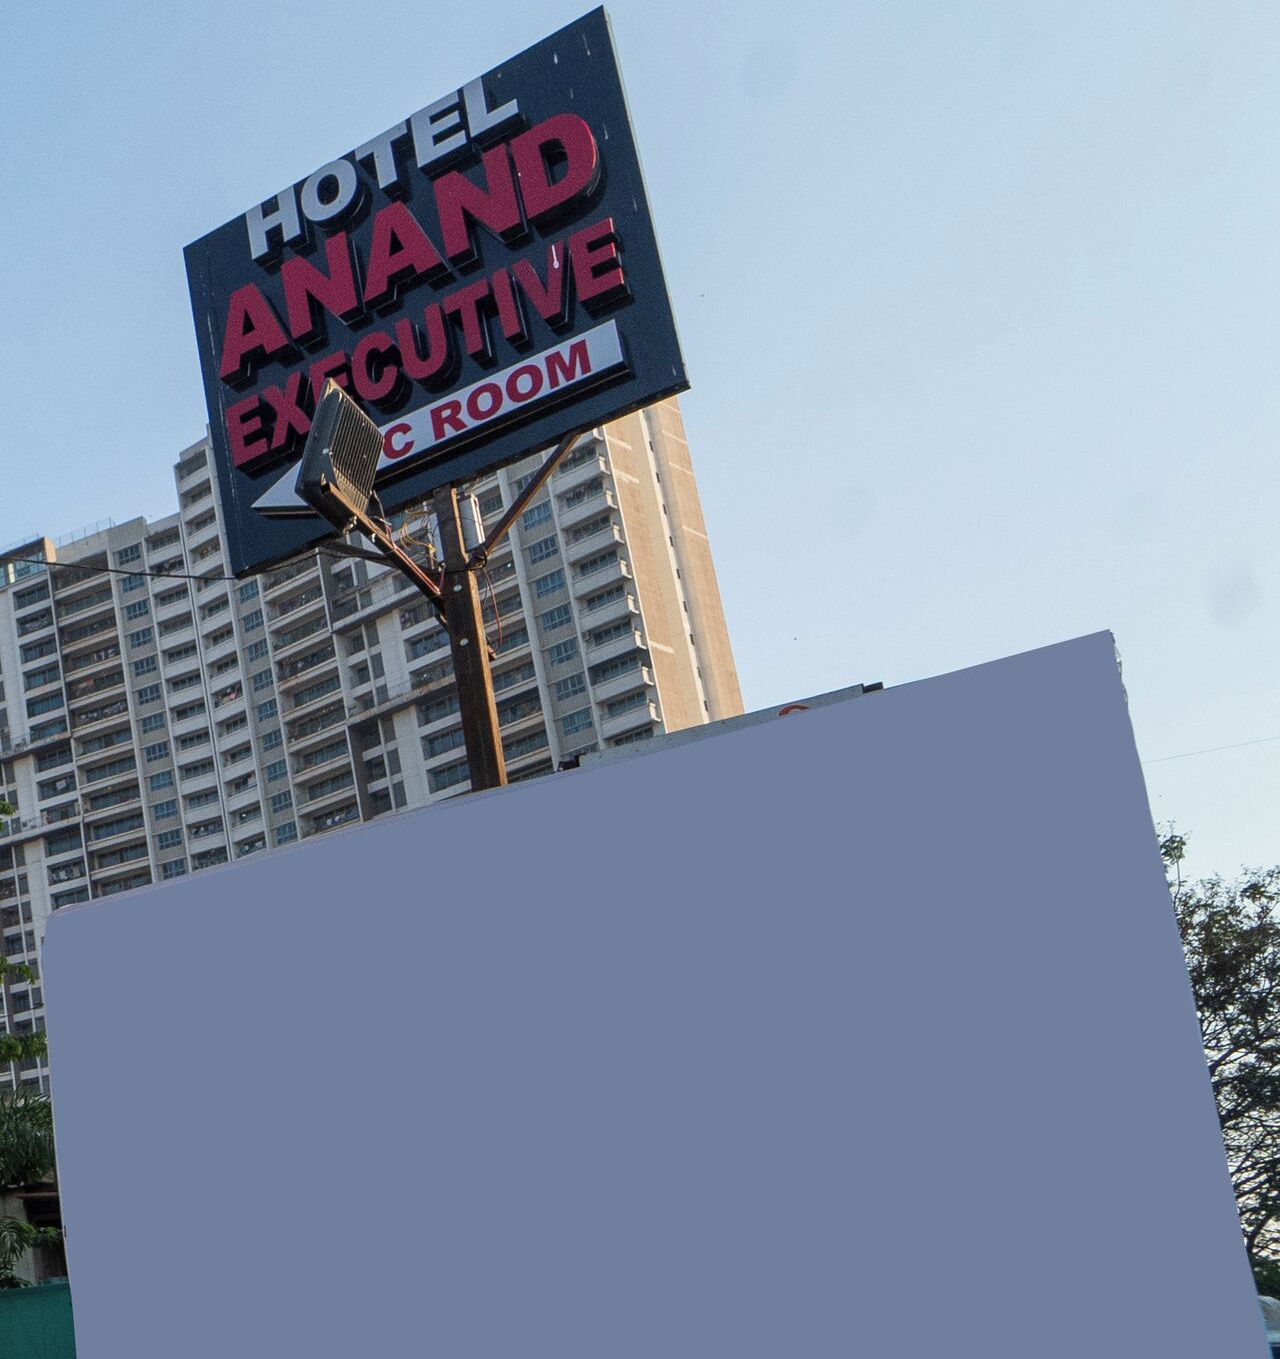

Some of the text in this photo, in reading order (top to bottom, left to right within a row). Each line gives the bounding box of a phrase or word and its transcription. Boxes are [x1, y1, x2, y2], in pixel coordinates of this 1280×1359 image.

[219, 112, 599, 383] ANAND
[244, 76, 519, 260] HOTEL
[225, 216, 625, 467] EXECUTIVE
[429, 339, 592, 442] ROOM
